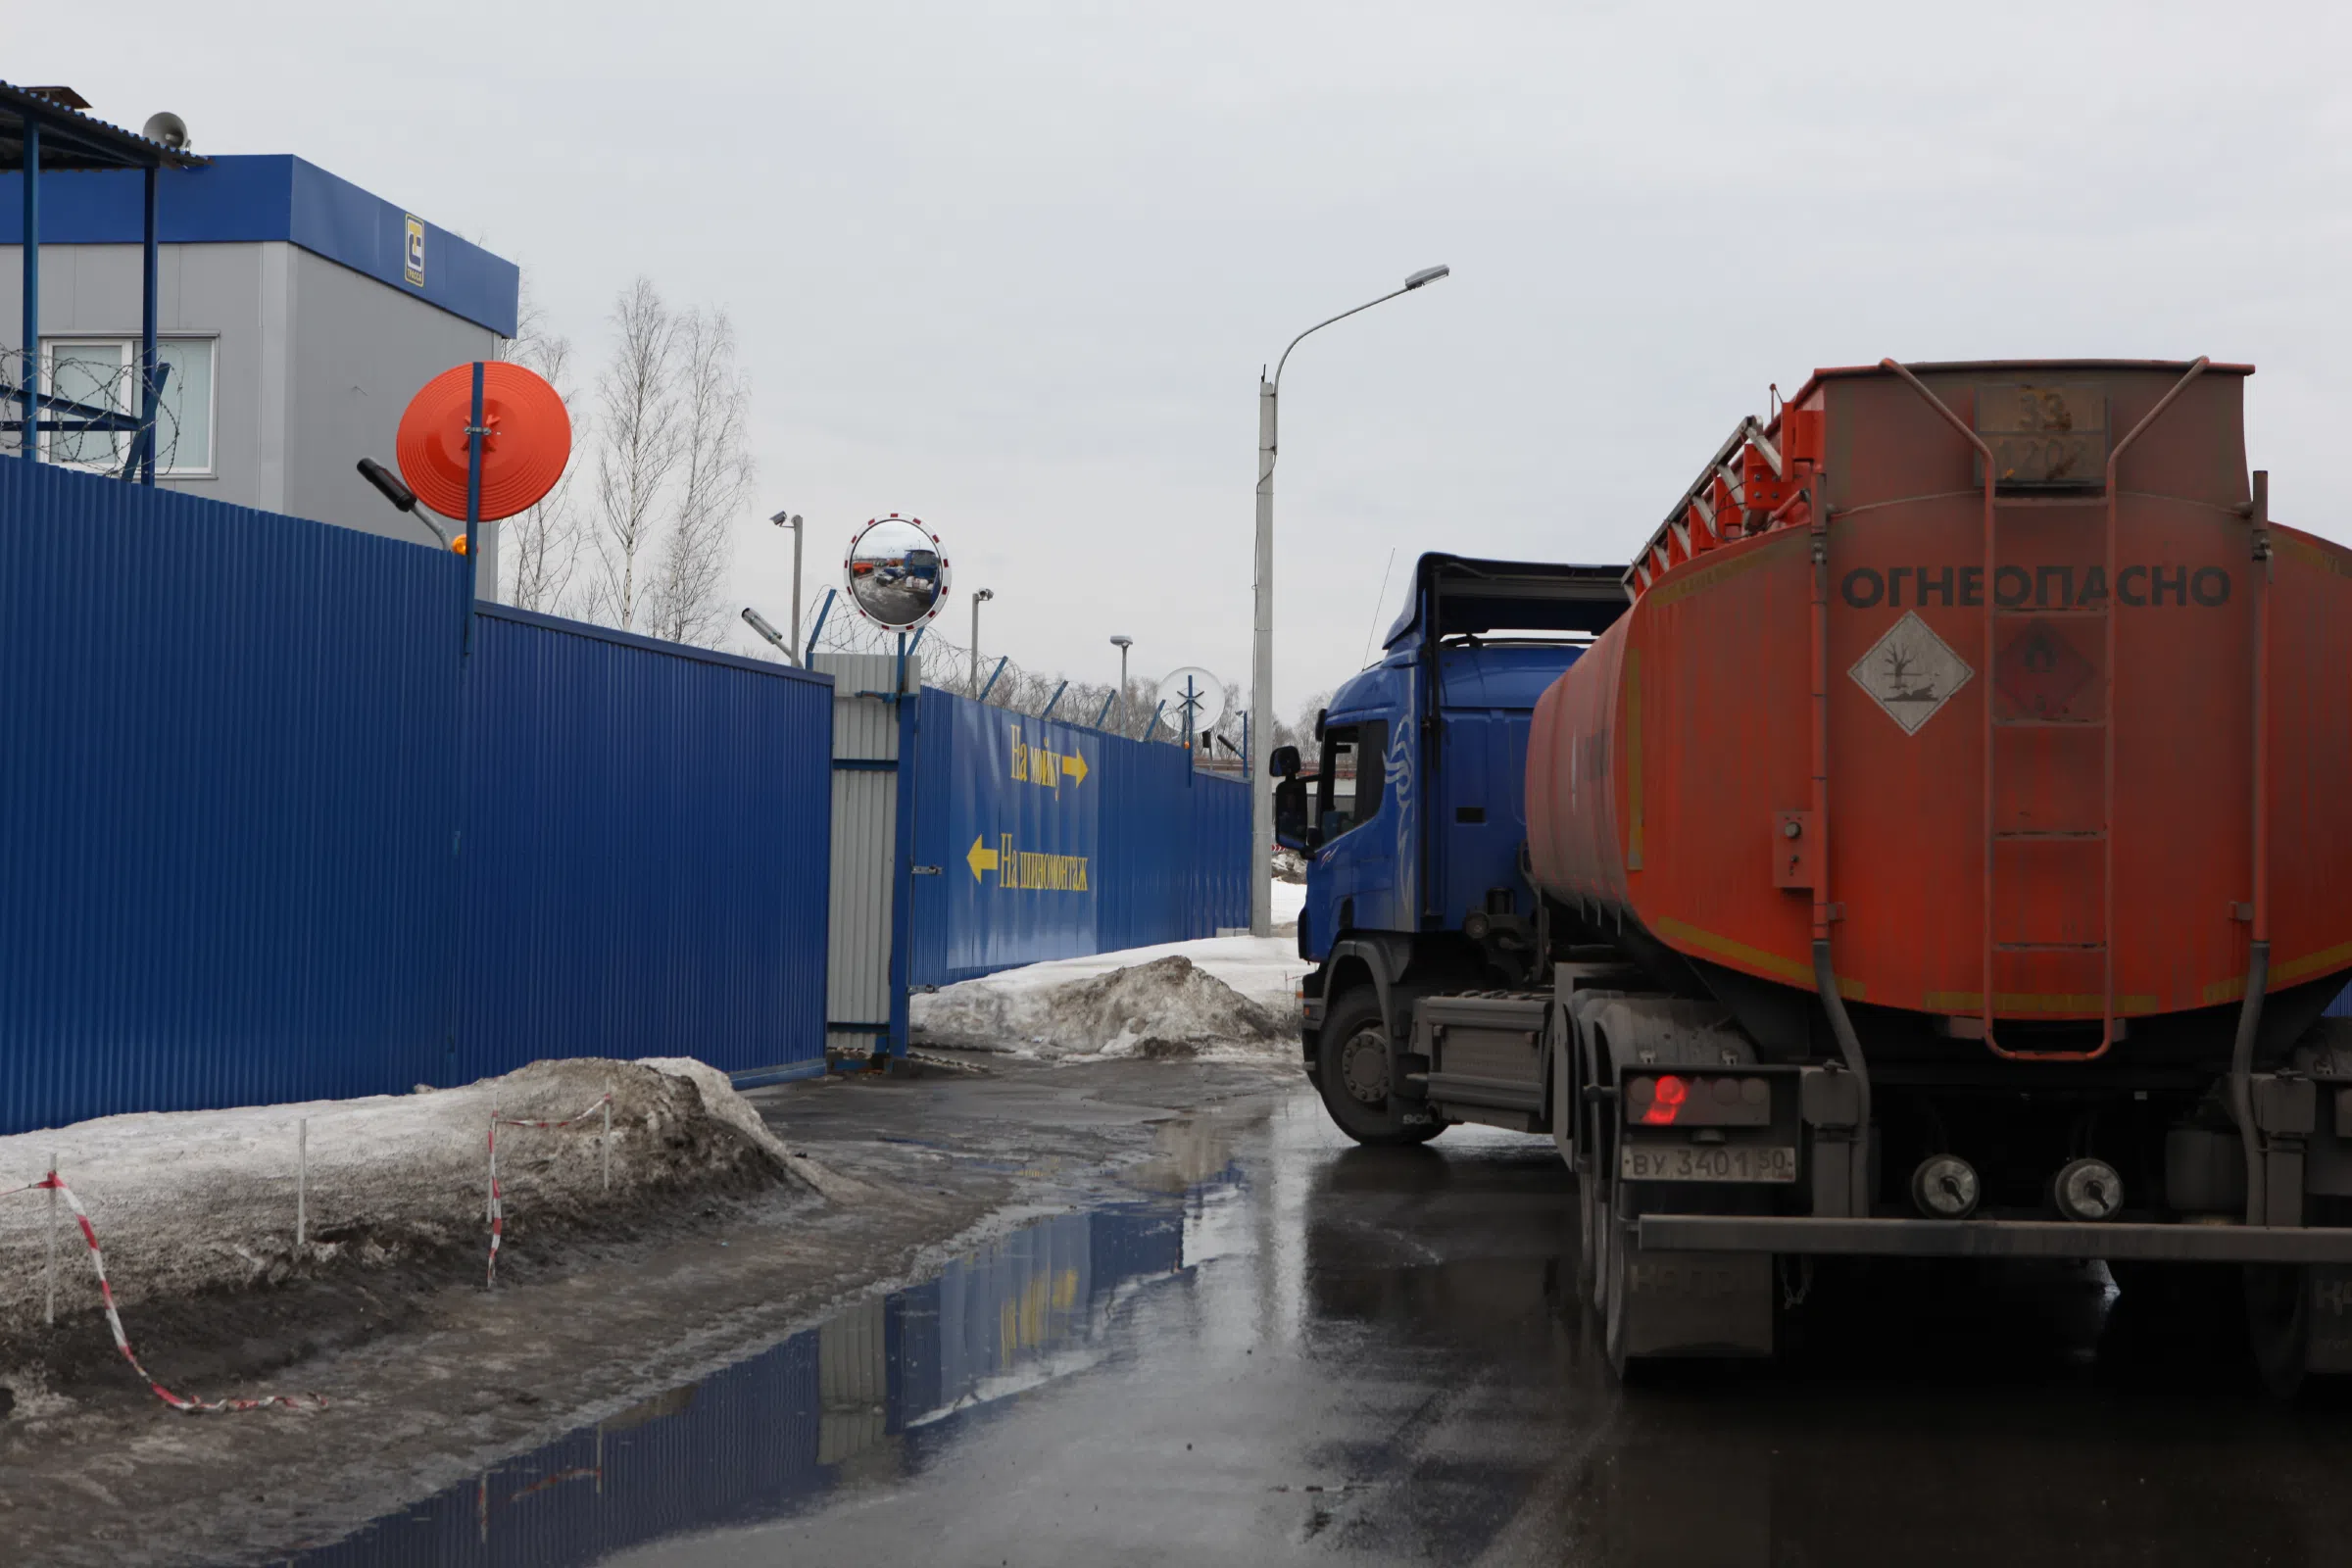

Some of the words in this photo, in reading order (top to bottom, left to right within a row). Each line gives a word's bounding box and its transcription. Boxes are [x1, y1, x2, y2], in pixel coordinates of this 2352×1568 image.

[1841, 564, 2231, 610] ОГНЕОПАСНО
[1010, 723, 1027, 782] На
[1030, 737, 1060, 802] мойку
[1000, 833, 1017, 889] На
[1019, 852, 1089, 892] шиномонтаж
[1677, 1149, 1748, 1176] 3401
[1758, 1149, 1787, 1171] 50
